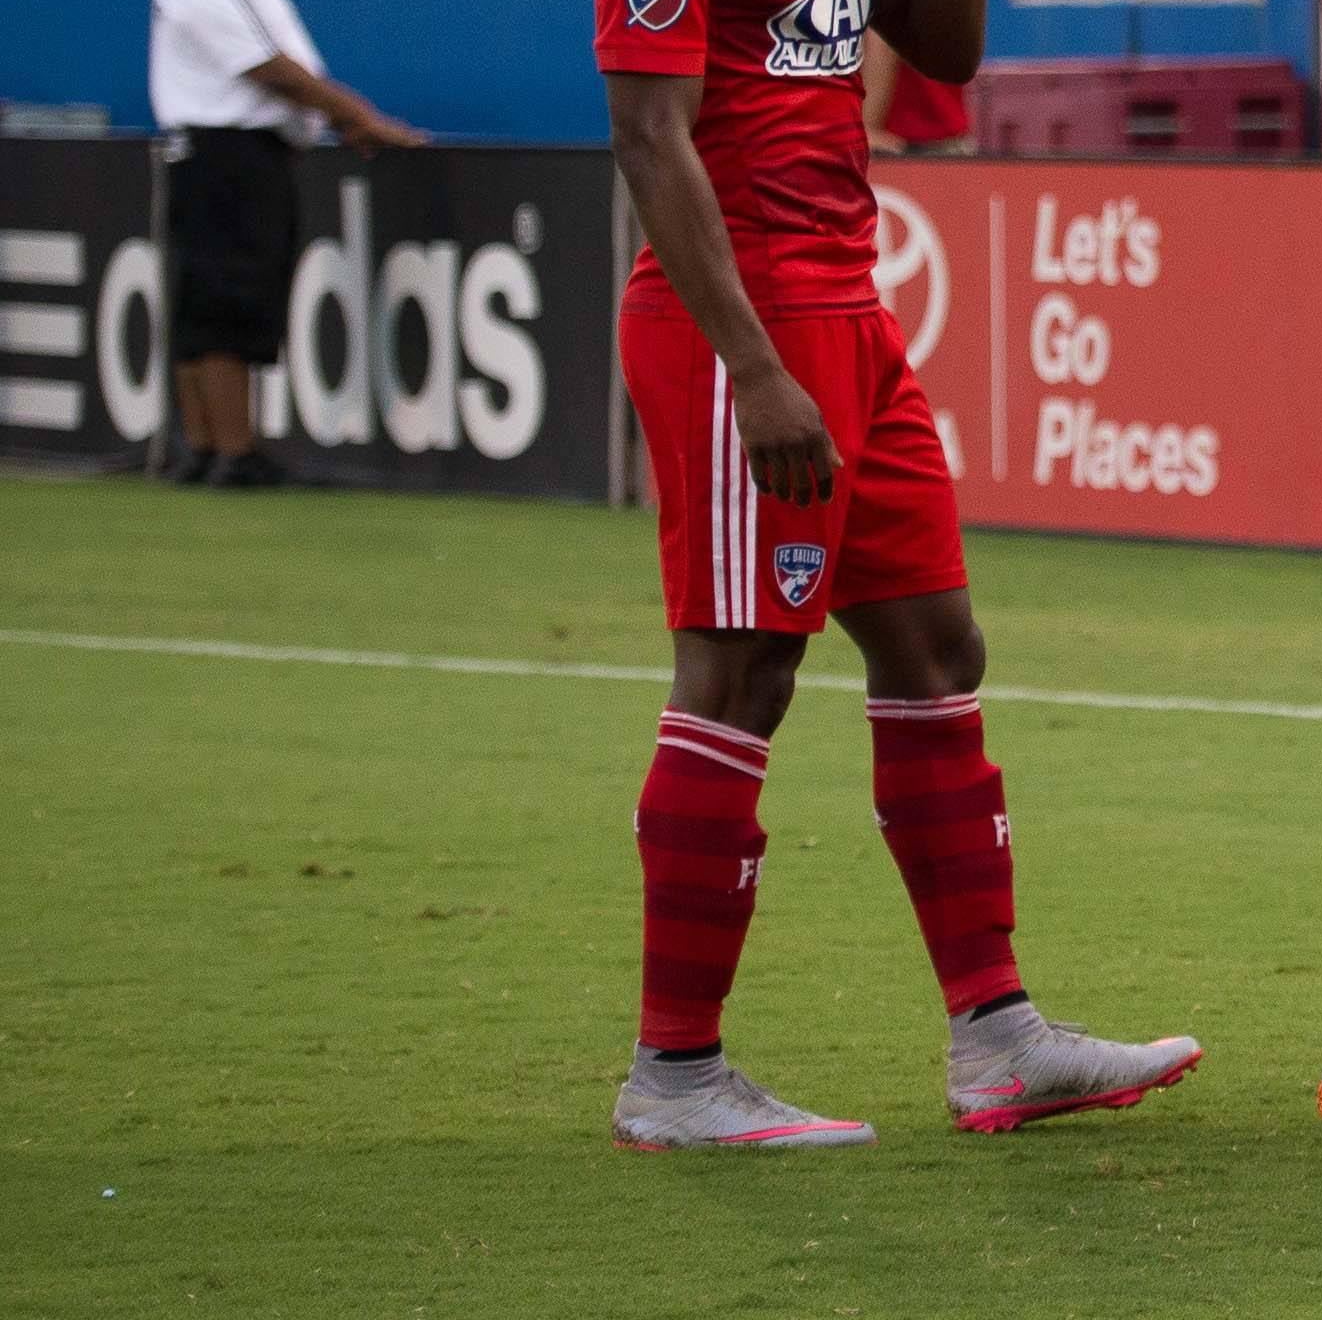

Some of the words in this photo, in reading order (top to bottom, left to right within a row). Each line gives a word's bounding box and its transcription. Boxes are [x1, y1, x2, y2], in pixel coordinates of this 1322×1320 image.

[96, 176, 548, 461] adas
[1029, 291, 1112, 386] Go
[1032, 397, 1222, 496] Places
[779, 549, 791, 565] FC
